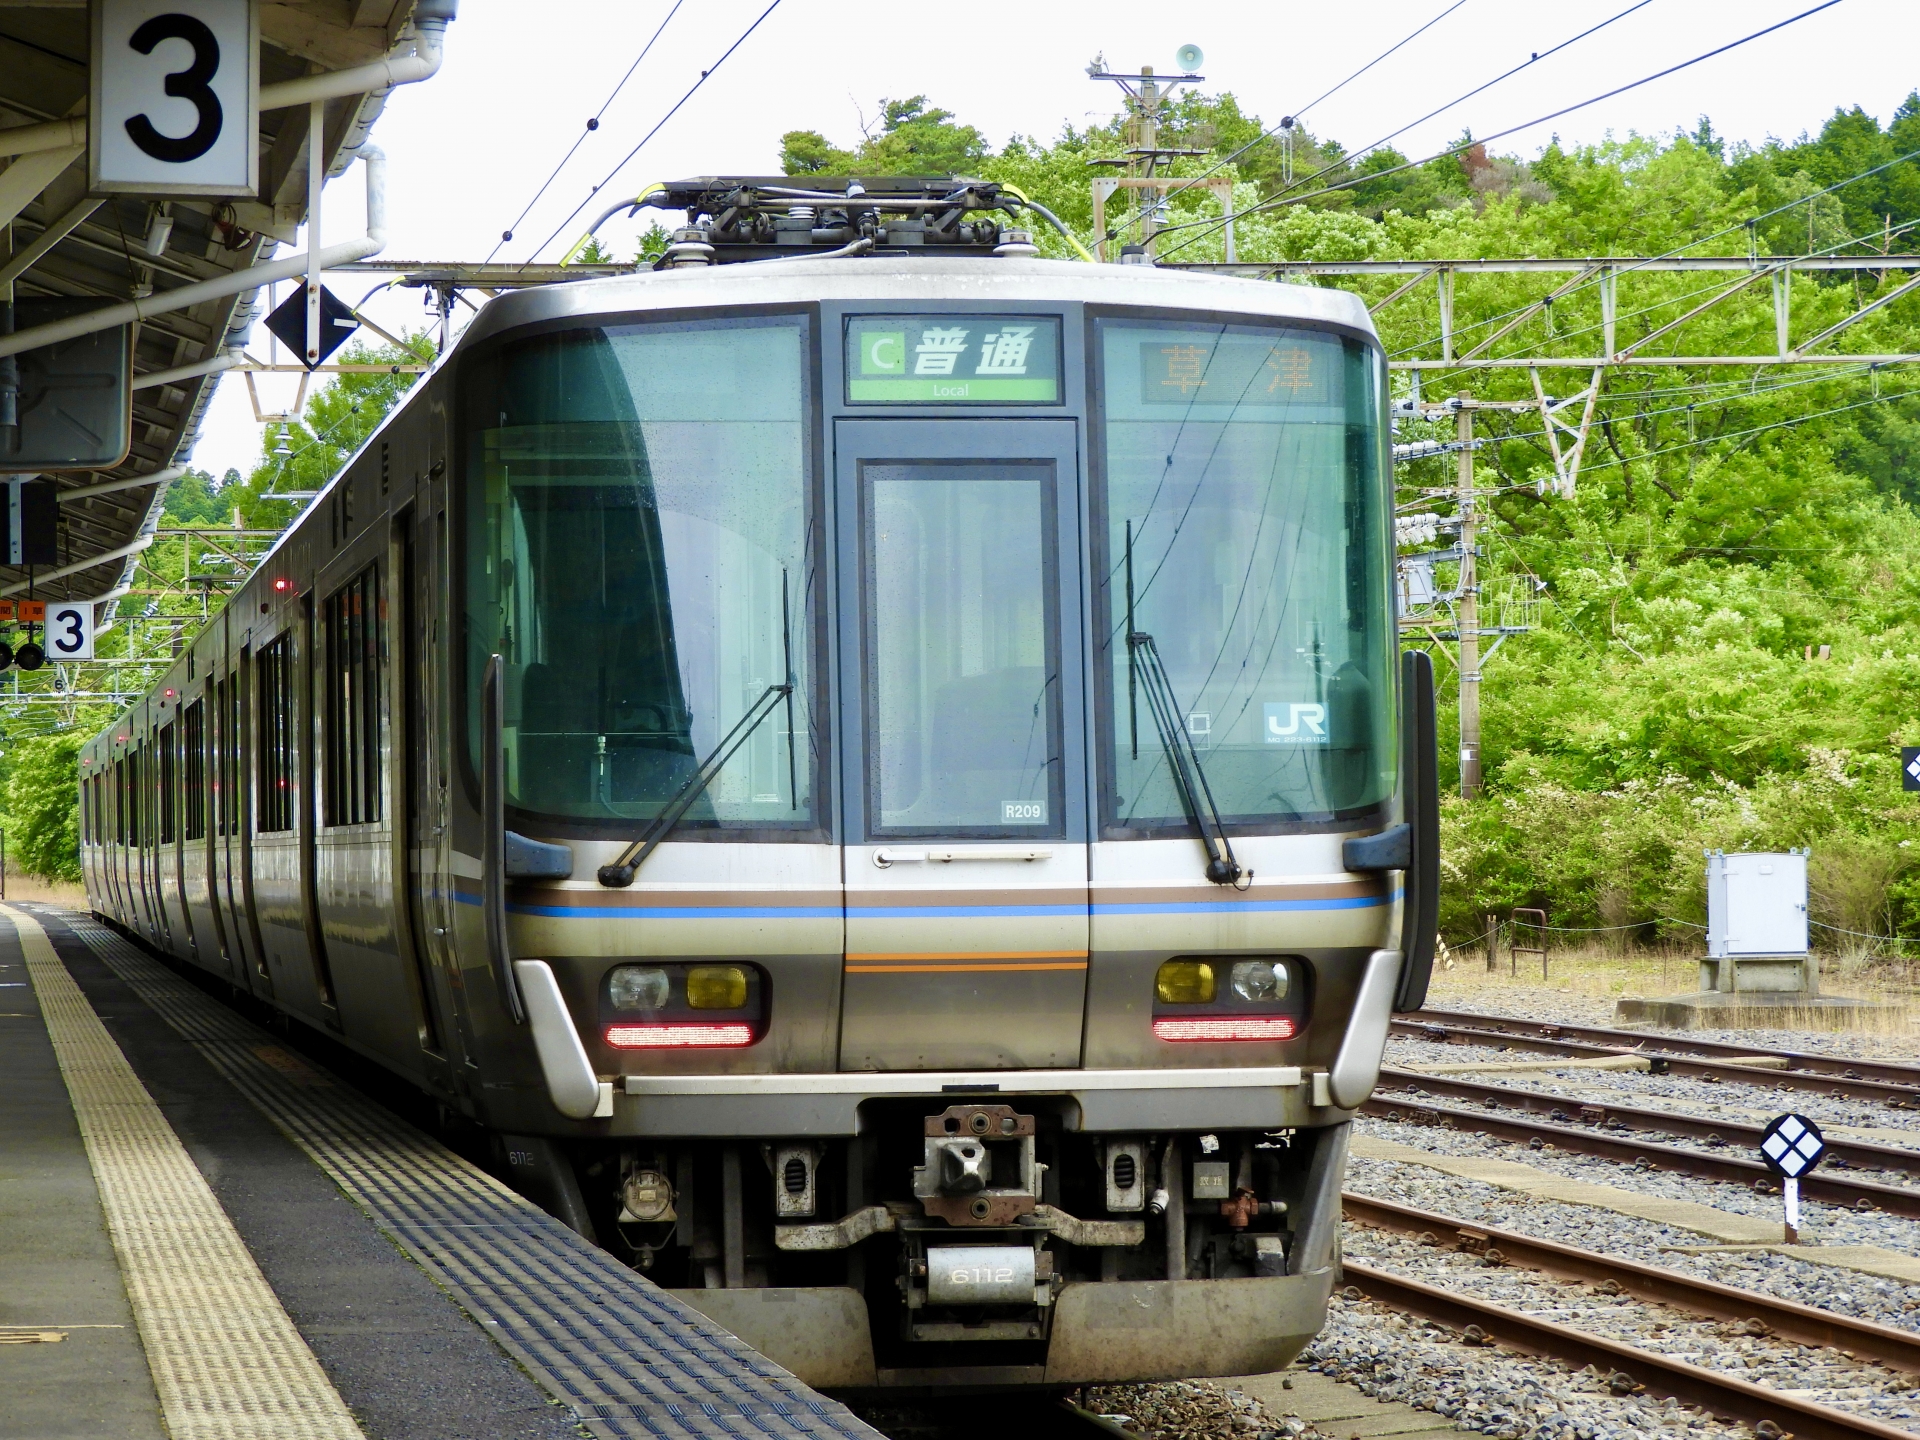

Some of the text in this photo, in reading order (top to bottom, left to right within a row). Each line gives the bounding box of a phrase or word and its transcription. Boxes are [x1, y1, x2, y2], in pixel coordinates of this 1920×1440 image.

[124, 13, 223, 163] 3
[871, 326, 1038, 375] C 普通
[1160, 345, 1313, 395] 草津
[933, 383, 969, 397] Local
[55, 609, 84, 653] 3
[1268, 703, 1326, 736] JR
[1005, 804, 1041, 818] R209
[509, 1151, 535, 1166] 6112
[951, 1268, 1014, 1284] 6112
